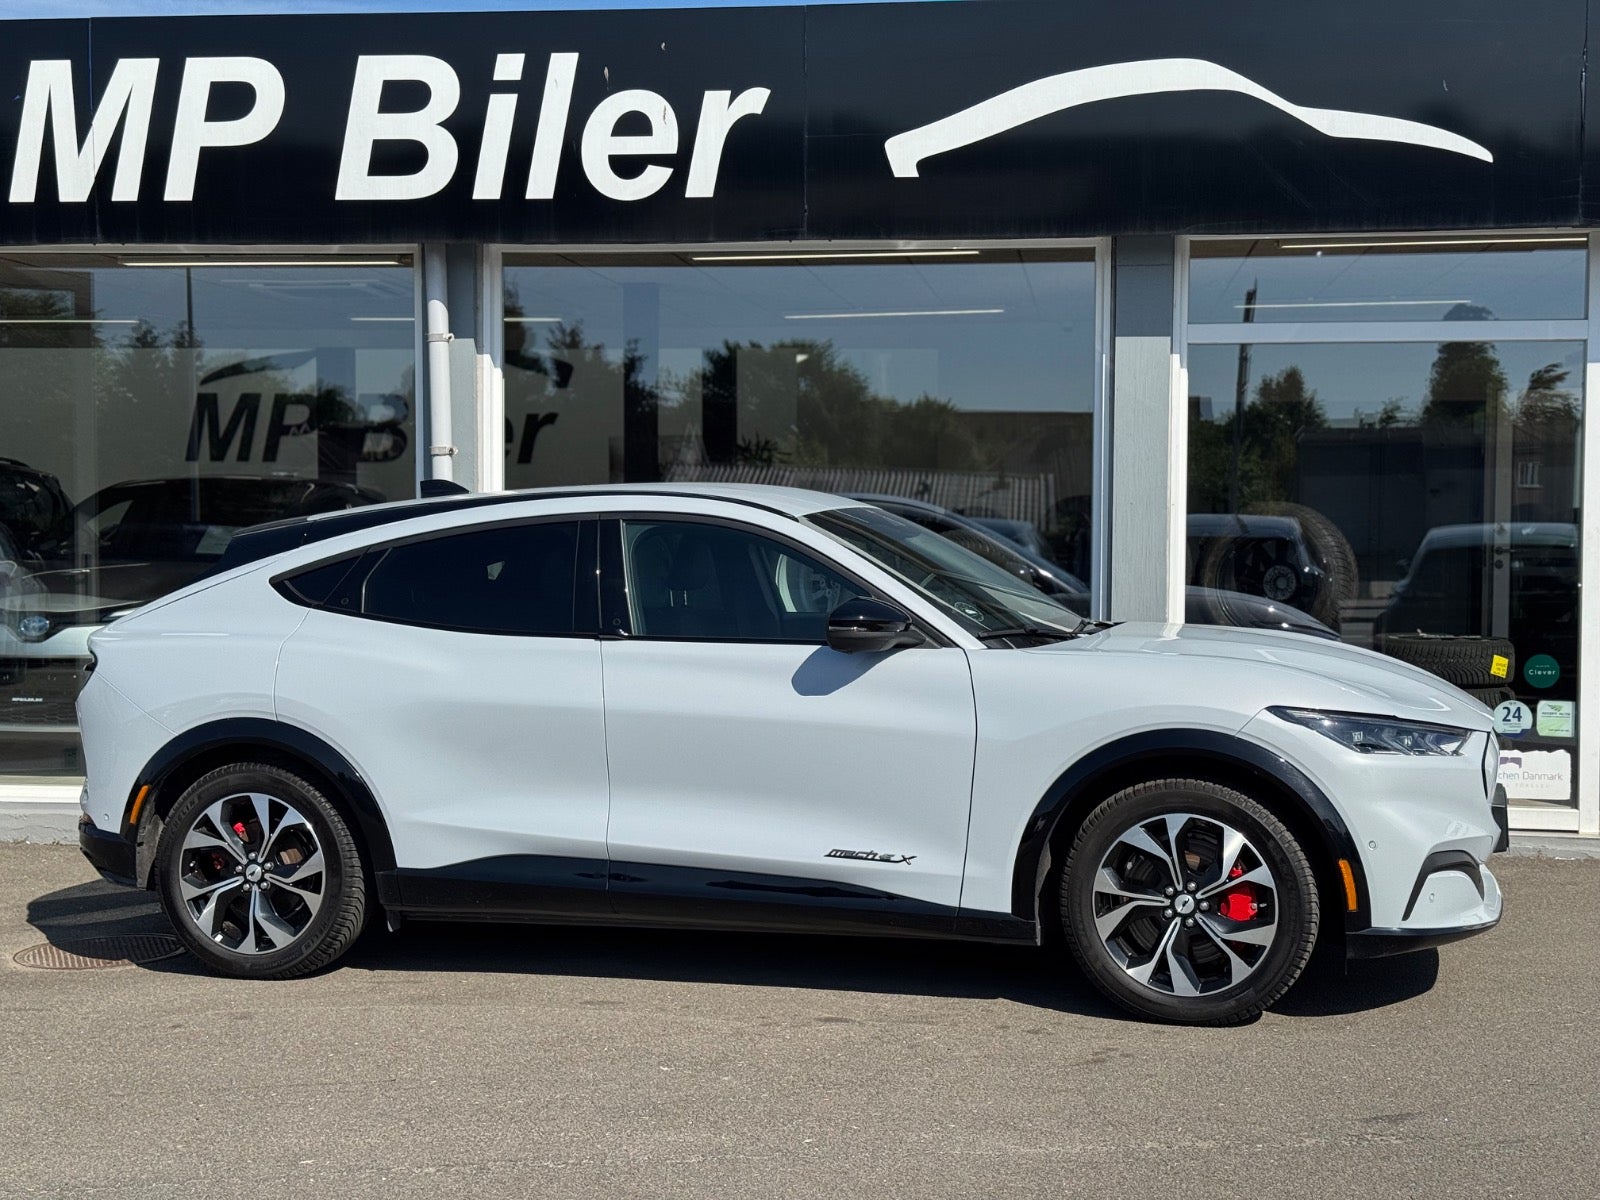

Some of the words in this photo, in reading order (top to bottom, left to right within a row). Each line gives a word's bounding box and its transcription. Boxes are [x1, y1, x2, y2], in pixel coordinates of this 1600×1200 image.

[9, 57, 285, 202] MP
[335, 53, 770, 200] Biler
[185, 392, 314, 463] MP
[1502, 706, 1522, 723] 24
[1497, 771, 1520, 781] chen
[1522, 771, 1564, 781] Danmark
